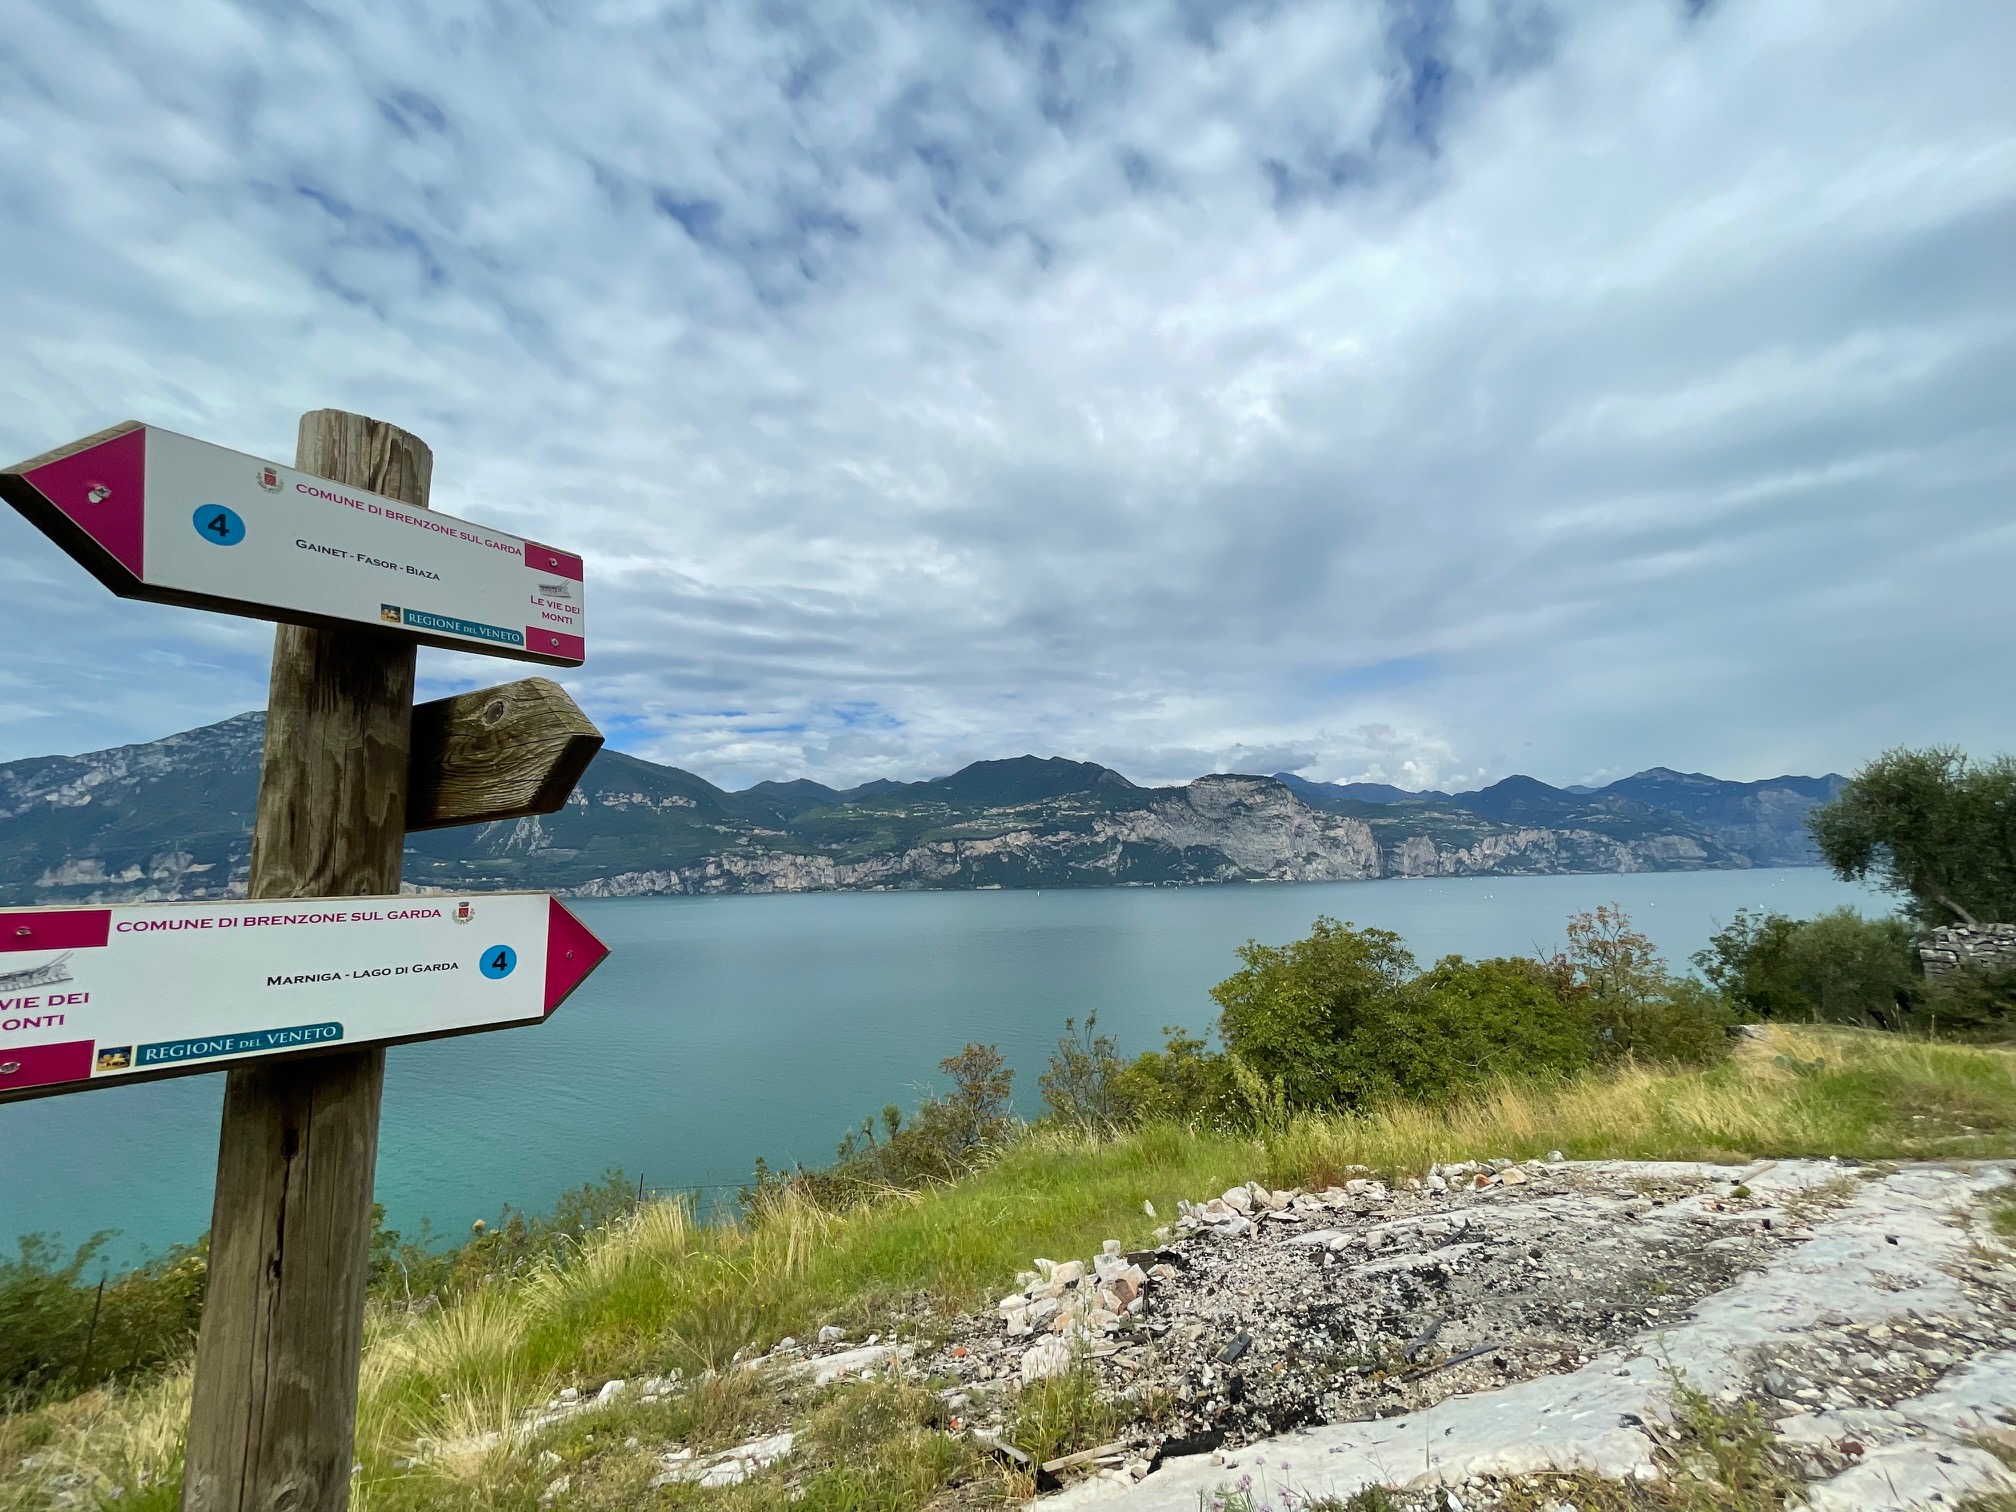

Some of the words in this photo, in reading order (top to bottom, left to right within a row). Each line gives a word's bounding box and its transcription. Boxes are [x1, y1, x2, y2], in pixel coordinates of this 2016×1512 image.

[207, 513, 230, 537] 4
[296, 483, 365, 511] COMUNE
[368, 503, 382, 516] DI
[385, 509, 458, 538] BRENZONE
[460, 531, 483, 546] SUL
[484, 539, 523, 557] GARDA
[408, 612, 461, 632] REGIONE
[463, 625, 477, 635] DEL
[479, 626, 521, 642] VENETO
[541, 611, 574, 625] MONTI
[116, 918, 214, 933] COMUNE
[218, 917, 239, 928] DI
[243, 912, 348, 927] BRENZONE
[350, 911, 384, 922] SUL
[387, 908, 442, 920] GARDA
[491, 951, 508, 972] 4
[47, 992, 90, 1007] DEI
[1, 1014, 65, 1031] ONTI
[145, 1038, 235, 1062] REGIONE
[239, 1038, 262, 1049] DEL
[266, 1026, 337, 1046] VENETO
